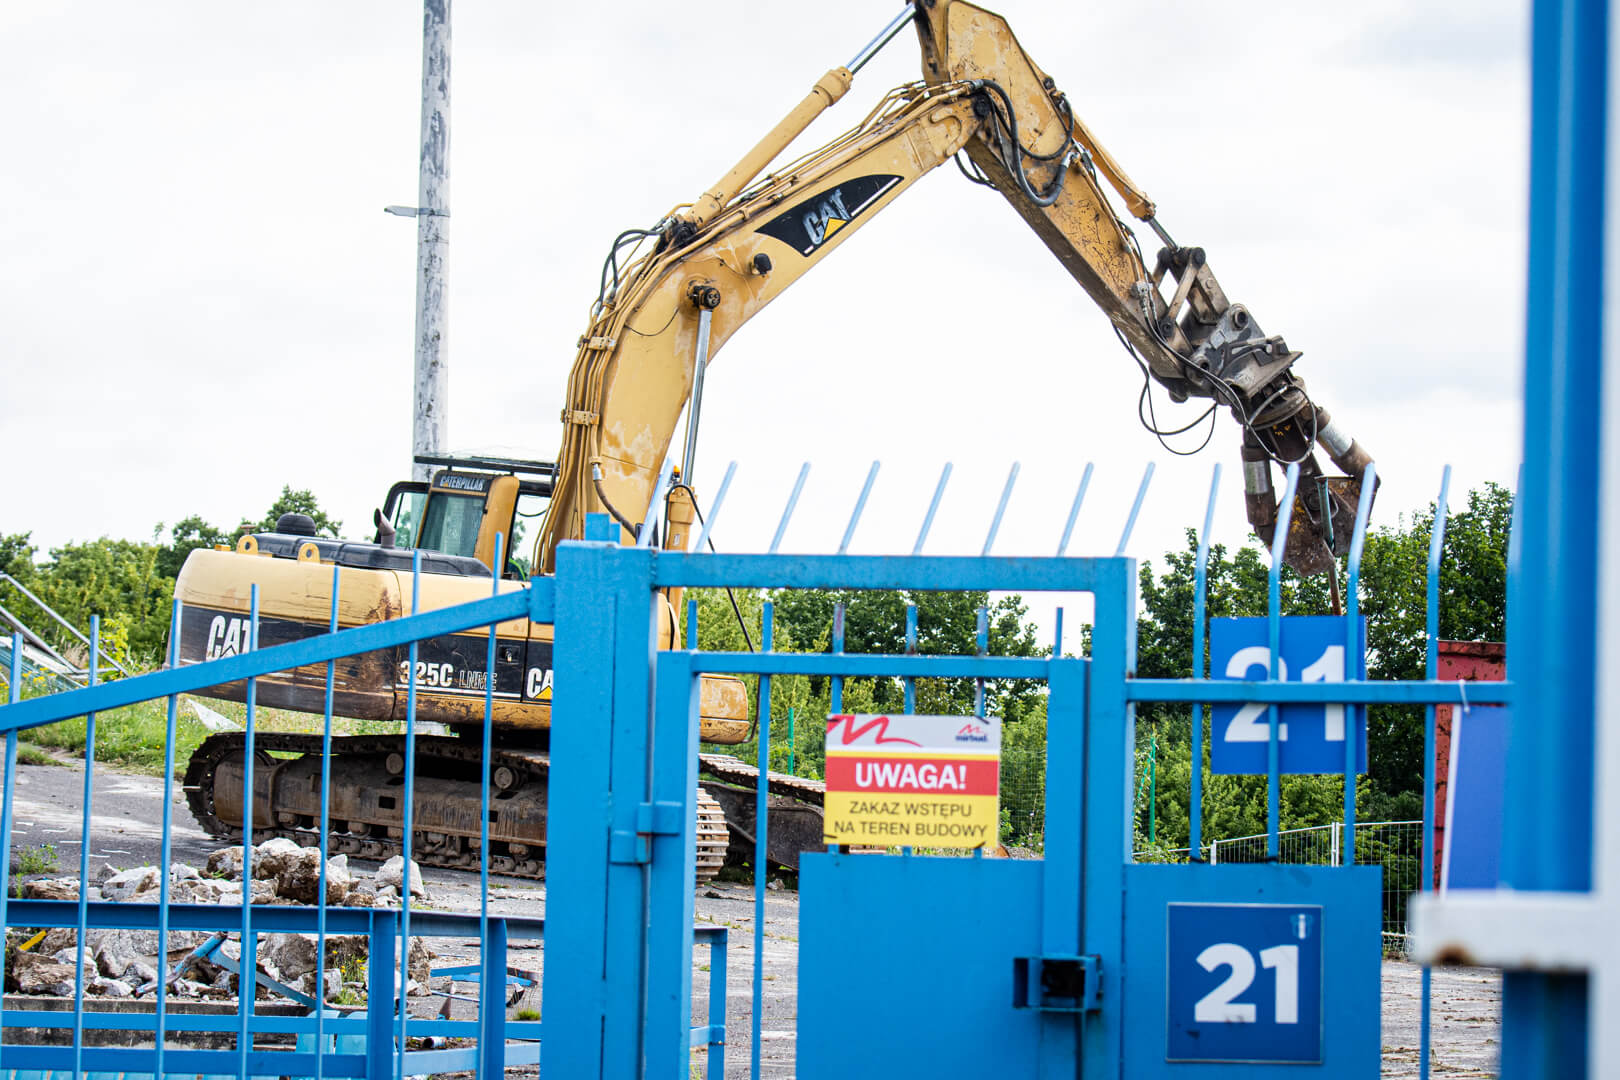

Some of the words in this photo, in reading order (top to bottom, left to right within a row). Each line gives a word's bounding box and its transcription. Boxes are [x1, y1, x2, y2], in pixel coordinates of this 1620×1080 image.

[803, 188, 851, 245] CAT
[440, 475, 484, 491] CATERPILLAR
[400, 661, 453, 687] 325C
[526, 668, 554, 698] CA
[1224, 645, 1345, 742] 21
[855, 762, 967, 790] UWAGA!
[849, 801, 900, 815] ZAKAZ
[904, 803, 972, 819] WSTĘPU
[834, 821, 855, 834] NA
[859, 821, 910, 836] TEREN
[915, 823, 988, 837] BUDOWY
[1194, 942, 1299, 1024] 21
